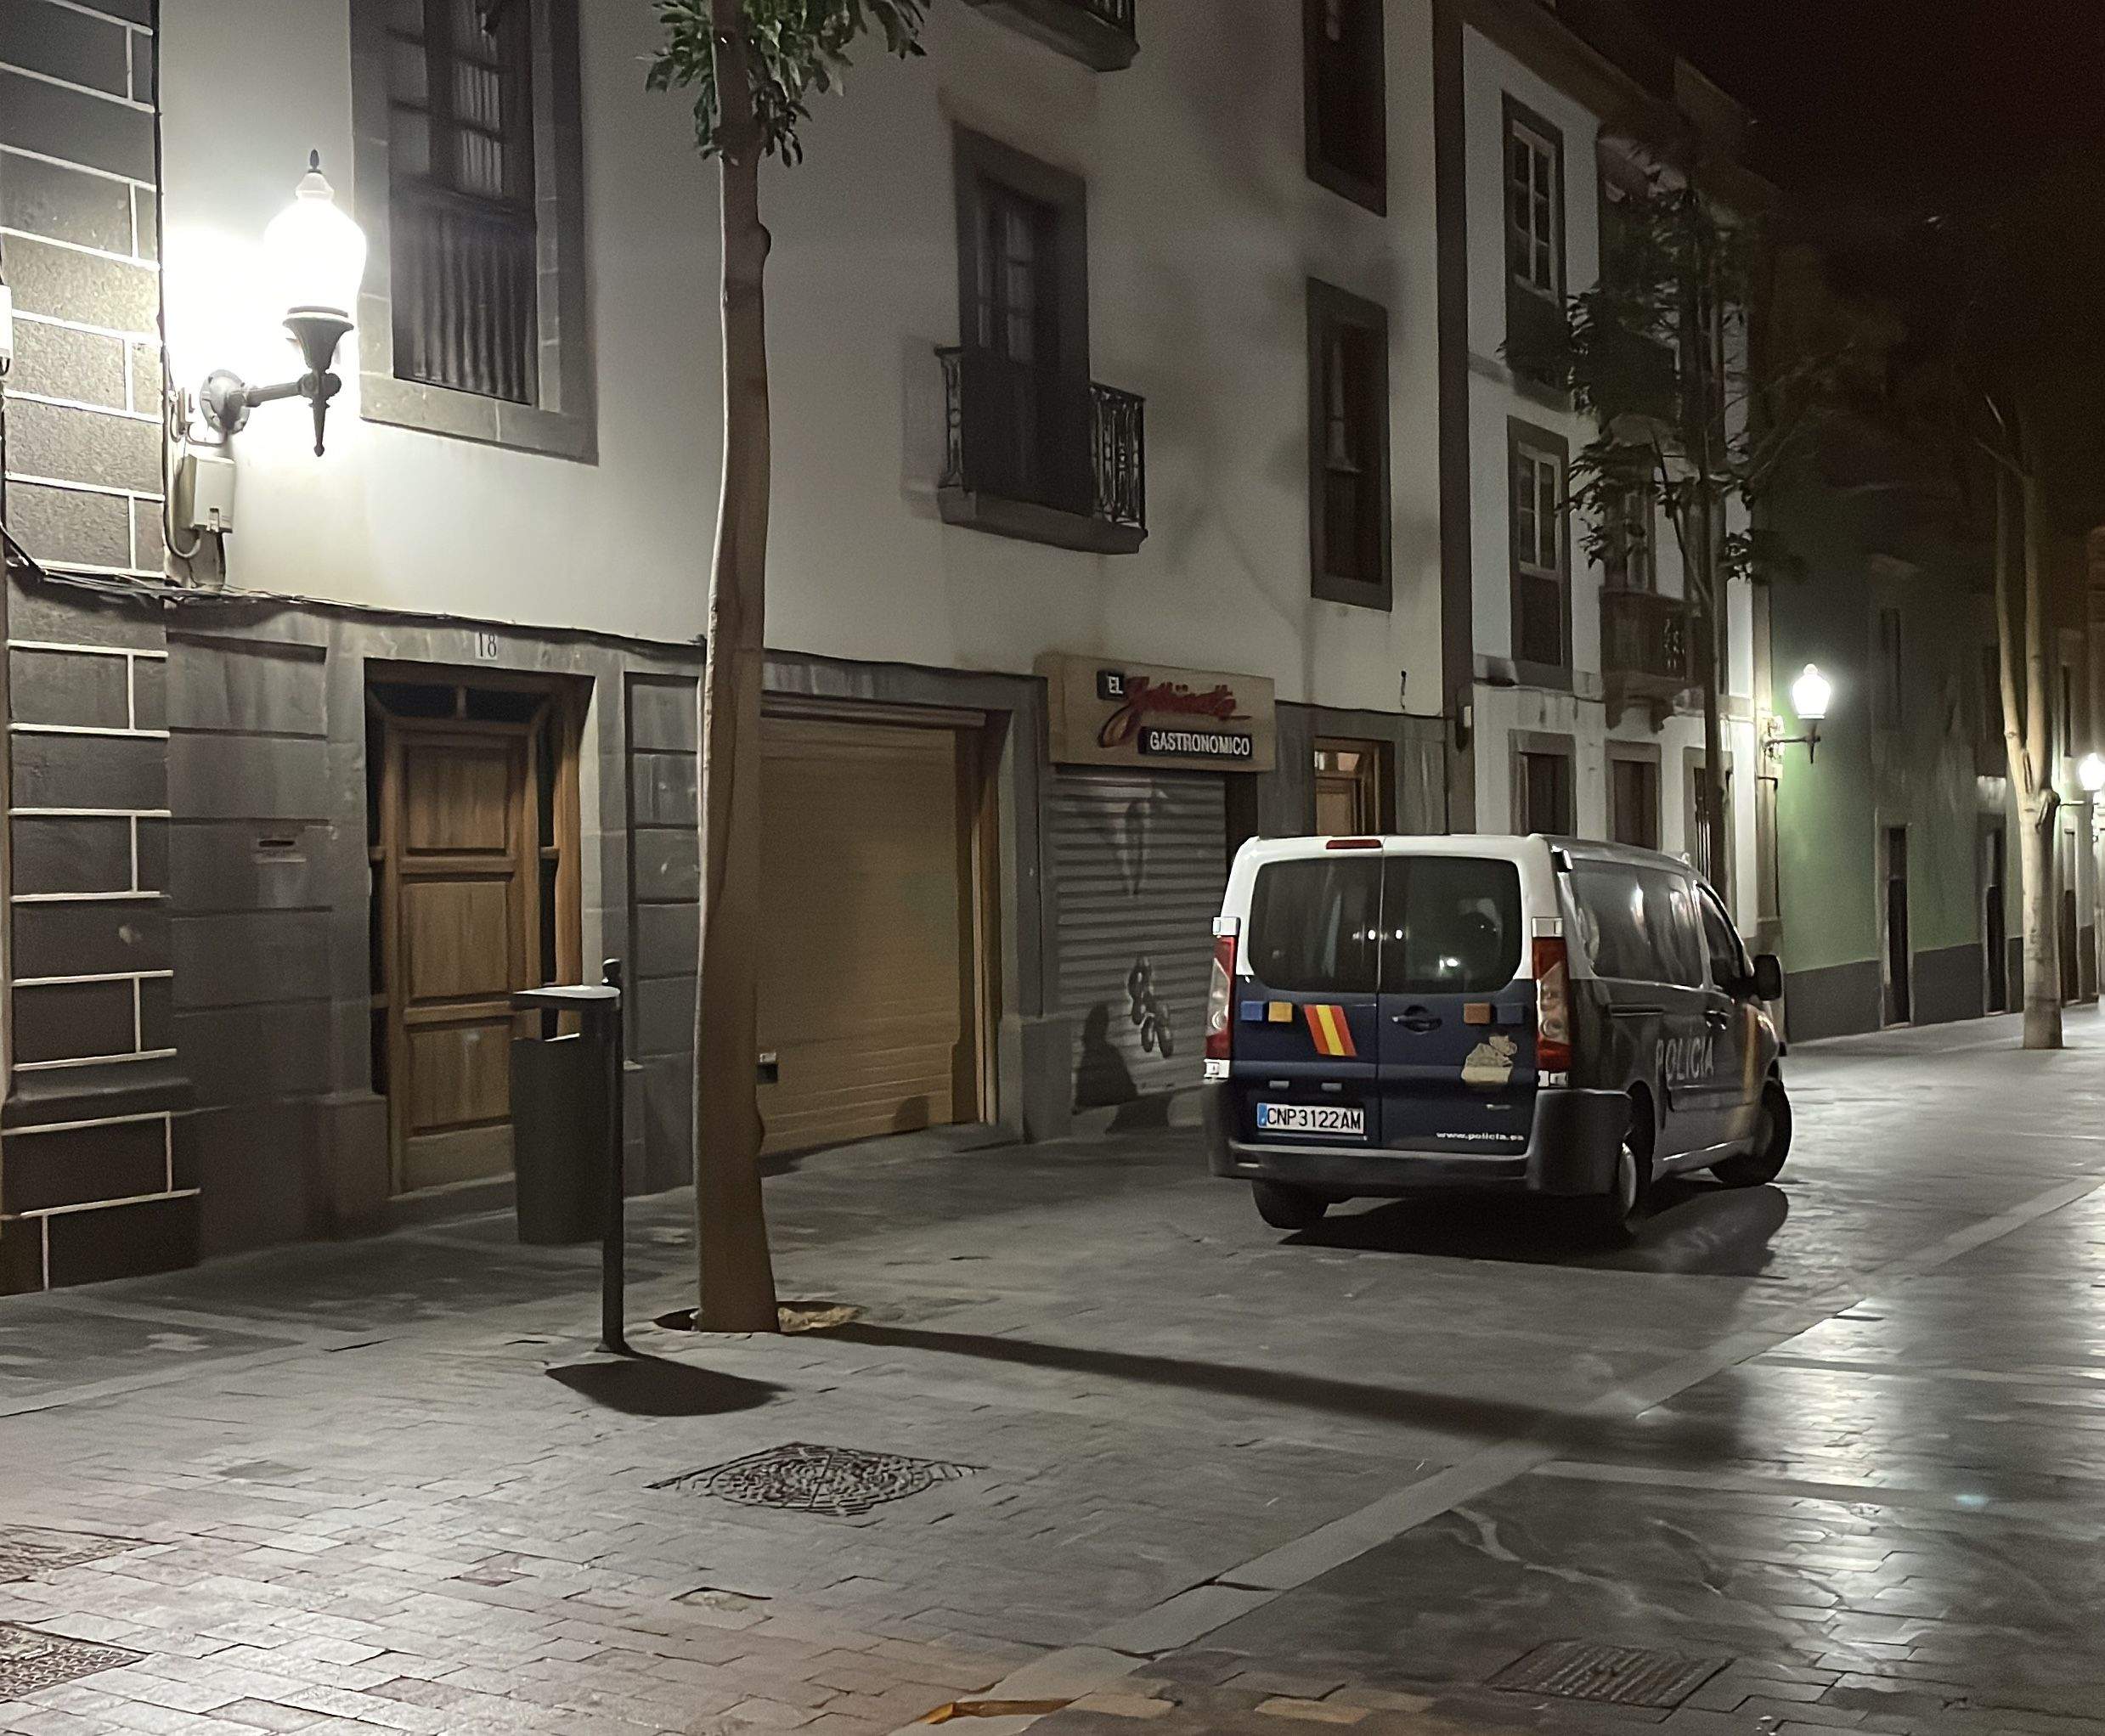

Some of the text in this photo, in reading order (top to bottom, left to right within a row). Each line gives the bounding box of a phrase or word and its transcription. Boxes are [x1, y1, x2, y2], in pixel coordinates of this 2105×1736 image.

[479, 632, 497, 657] 18
[1107, 675, 1124, 696] EL
[1149, 731, 1250, 756] GASTRONOMICO
[1267, 1108, 1362, 1130] CNP3122AM
